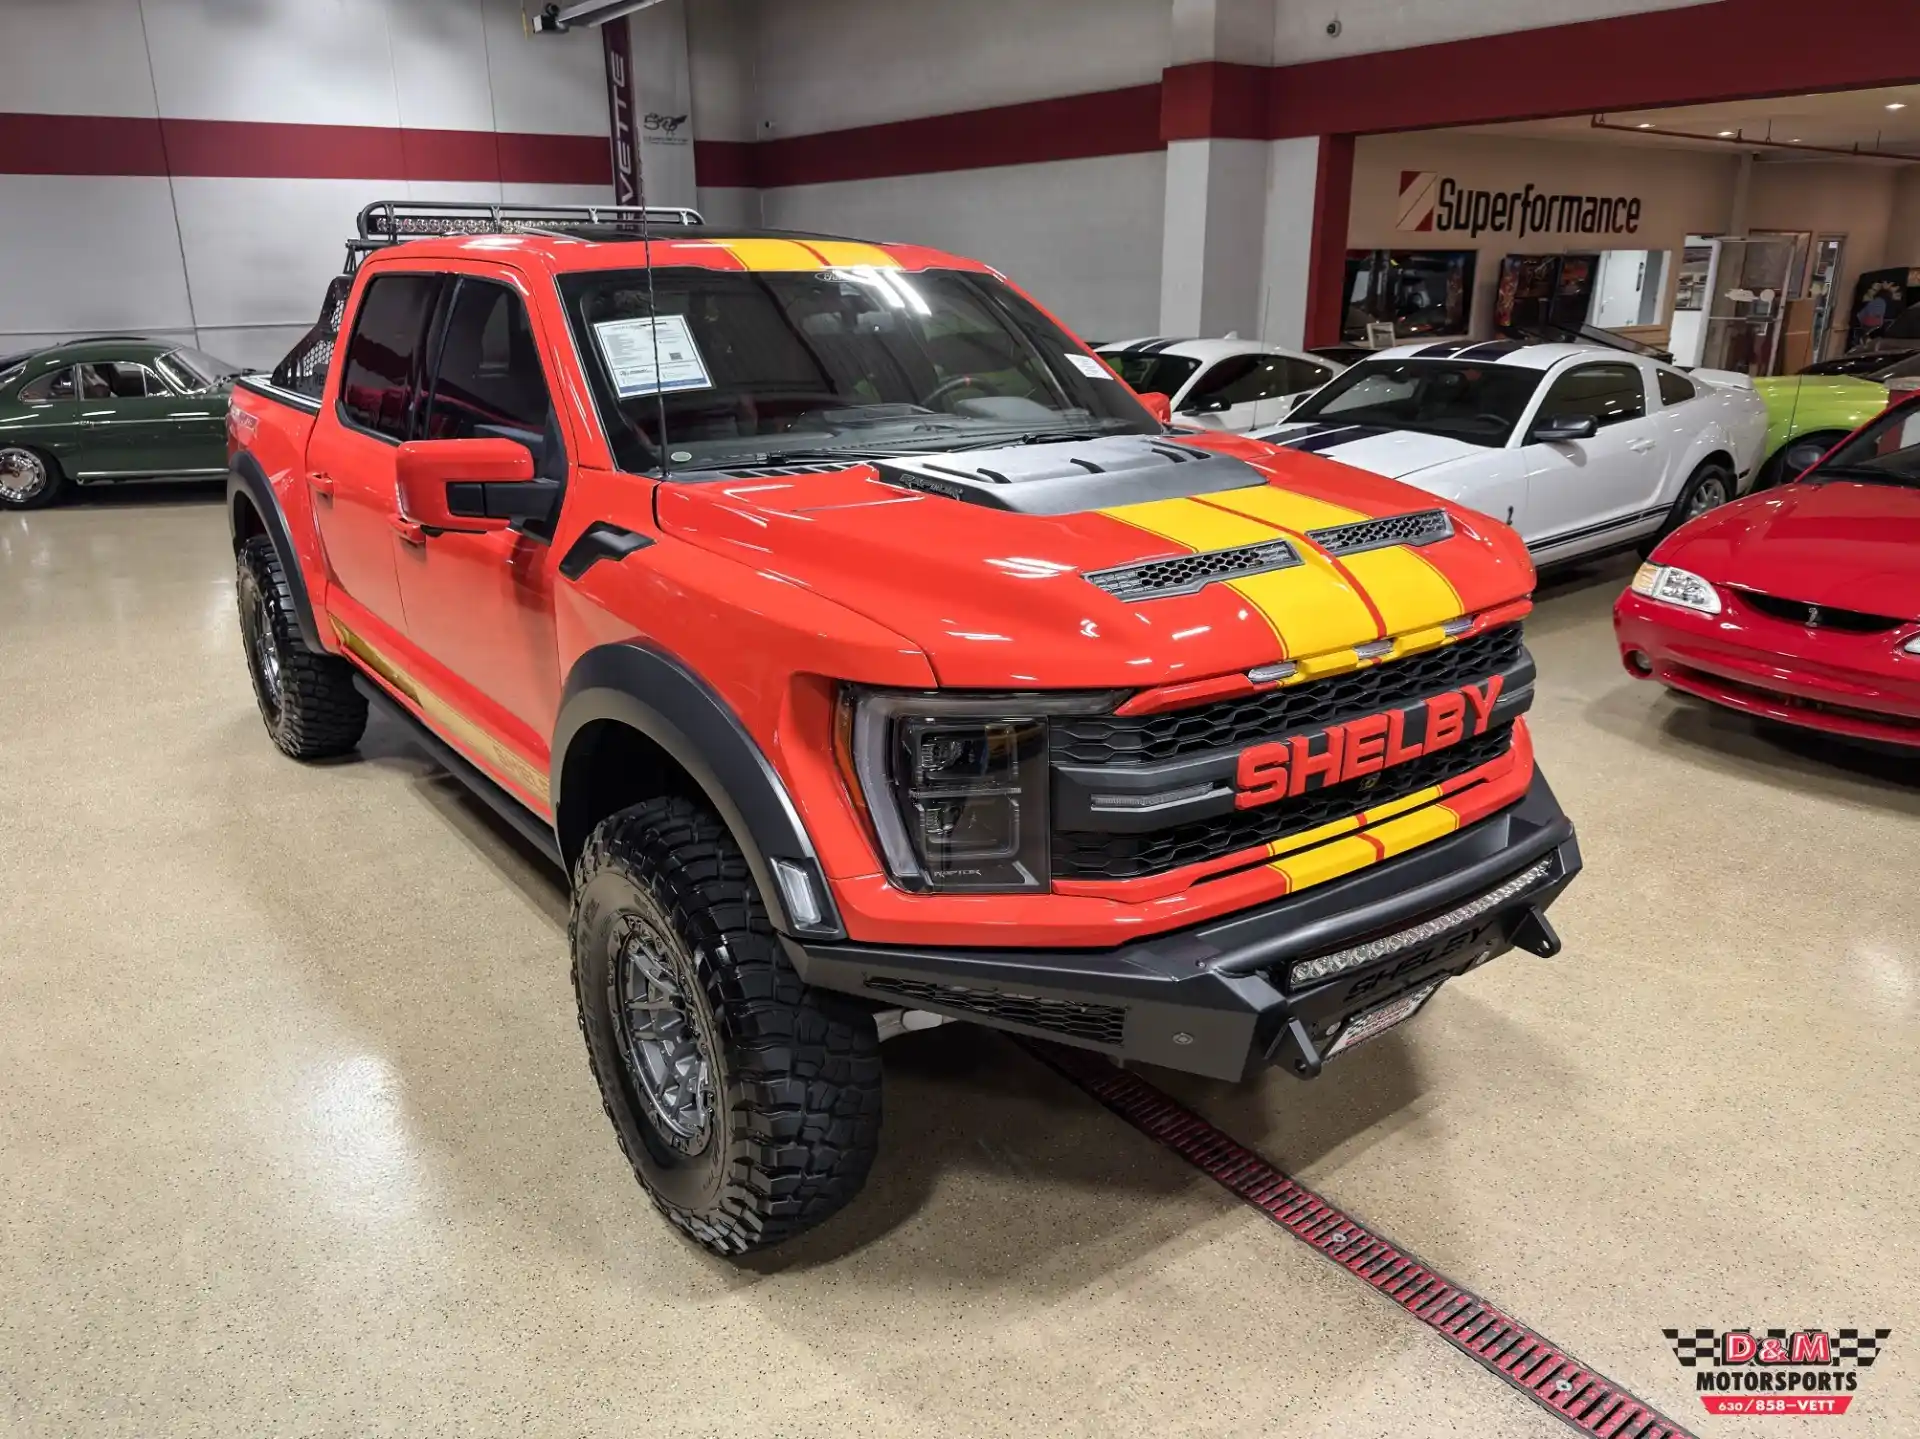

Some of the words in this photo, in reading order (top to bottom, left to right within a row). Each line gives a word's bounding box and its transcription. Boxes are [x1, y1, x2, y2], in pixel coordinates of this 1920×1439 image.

[611, 52, 633, 220] VETTE
[1436, 178, 1641, 238] Superformance
[1235, 674, 1504, 811] SHELBY
[1343, 920, 1493, 1002] SHELBY
